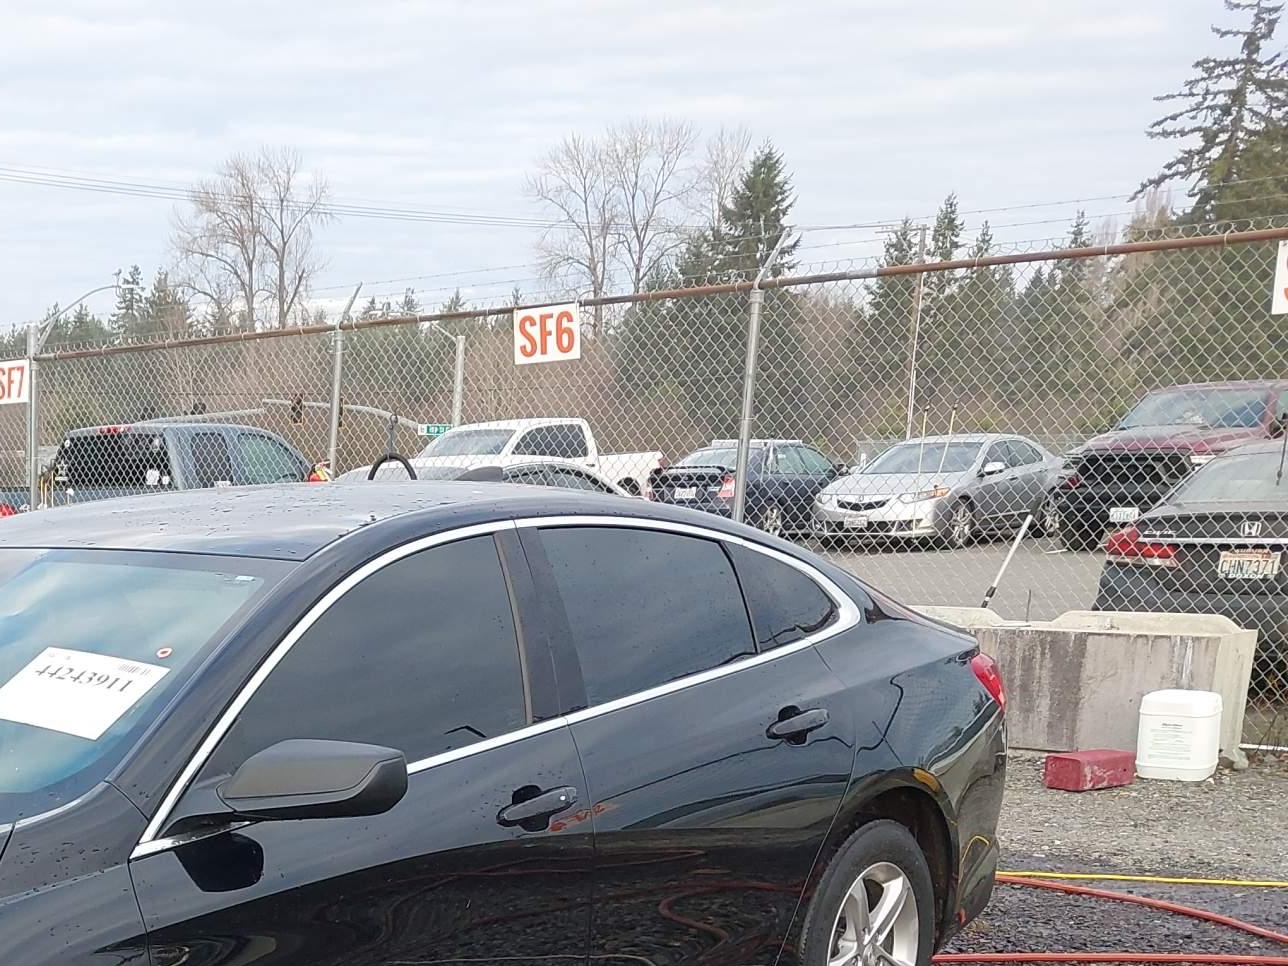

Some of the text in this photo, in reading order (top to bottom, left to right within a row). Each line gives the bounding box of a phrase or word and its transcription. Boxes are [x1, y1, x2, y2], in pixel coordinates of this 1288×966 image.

[519, 311, 575, 357] SF6
[1220, 559, 1276, 575] CHN7371
[35, 664, 134, 692] 44243911
